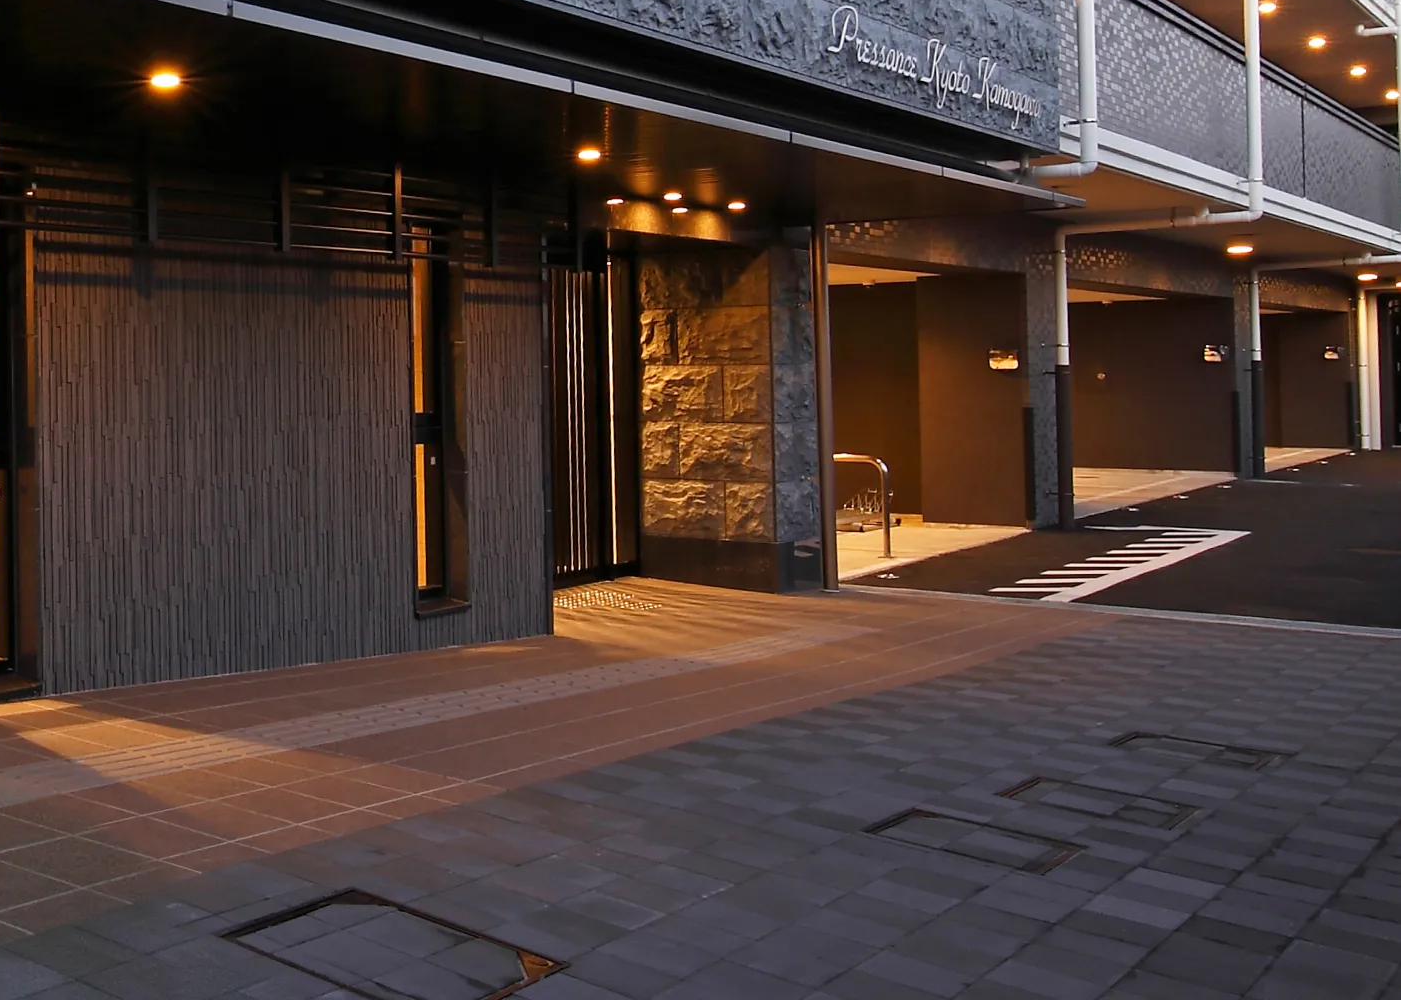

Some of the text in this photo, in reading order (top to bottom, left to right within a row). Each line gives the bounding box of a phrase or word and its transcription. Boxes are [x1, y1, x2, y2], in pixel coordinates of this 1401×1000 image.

[827, 5, 1041, 130] Pressance Kyoto Kamogawa
